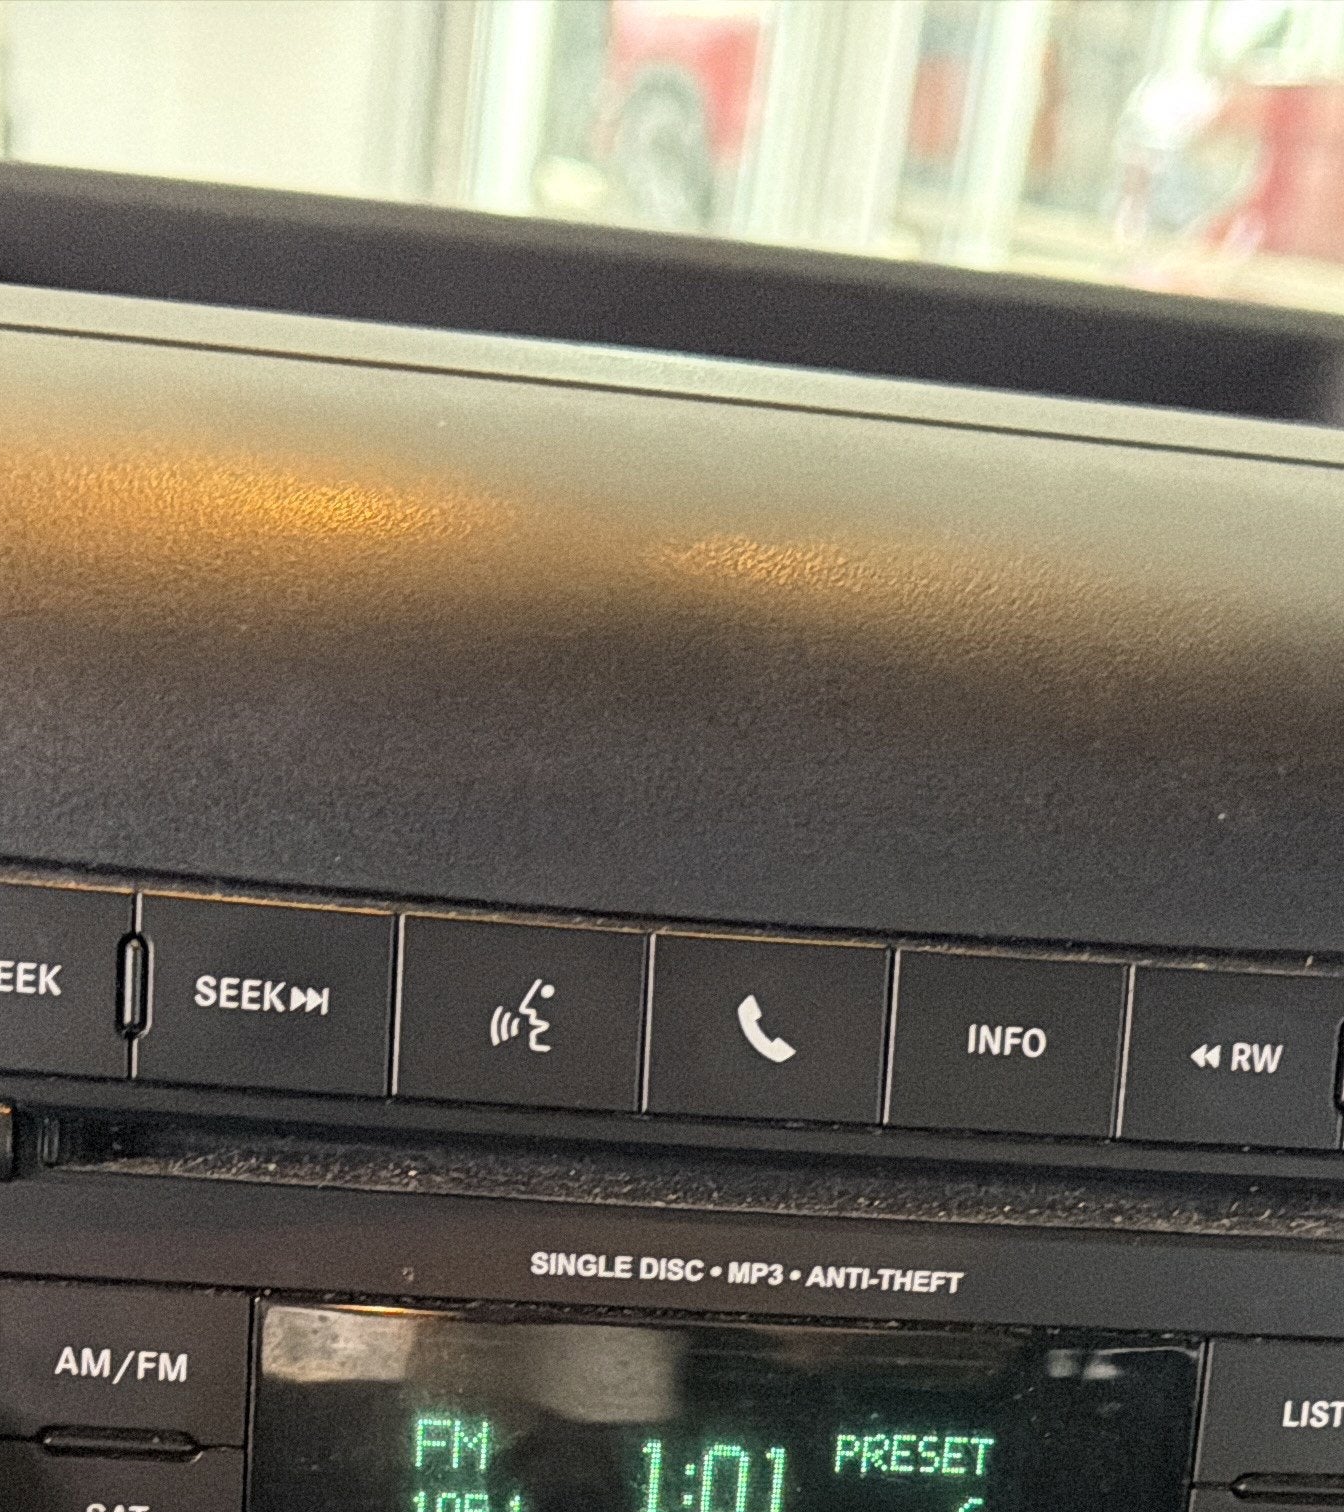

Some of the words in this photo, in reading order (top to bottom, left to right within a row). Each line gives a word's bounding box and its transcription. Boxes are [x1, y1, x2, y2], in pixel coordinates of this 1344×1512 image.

[194, 974, 286, 1013] SEEK
[966, 1023, 1048, 1058] INFO
[1230, 1042, 1285, 1074] RW
[529, 1251, 634, 1280] SINGLE
[639, 1255, 705, 1283] DISC
[727, 1260, 785, 1287] MP3
[805, 1265, 965, 1294] ANTI-THEFT
[54, 1346, 189, 1385] AM/FM
[413, 1416, 491, 1472] FM
[833, 1432, 996, 1476] PRESET
